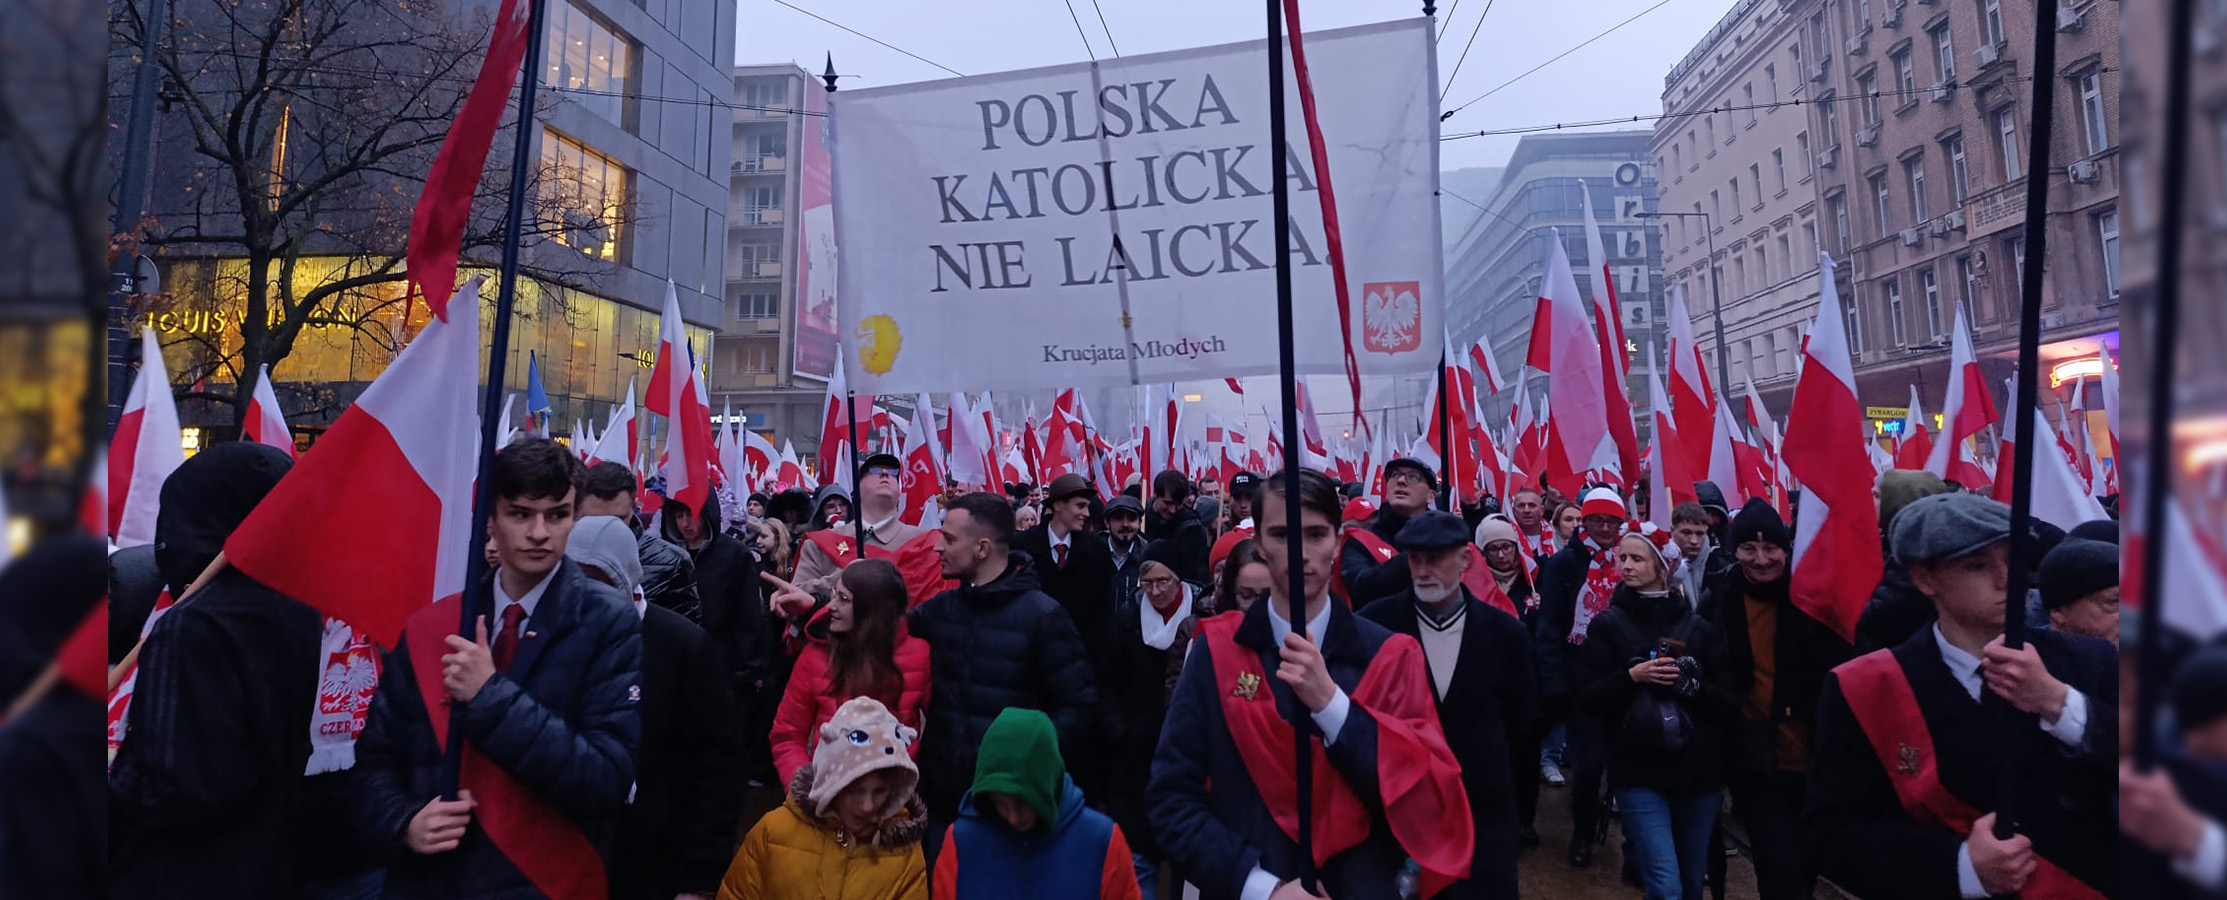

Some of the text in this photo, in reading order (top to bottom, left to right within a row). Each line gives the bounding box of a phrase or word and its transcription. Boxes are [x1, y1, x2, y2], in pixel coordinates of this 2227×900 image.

[975, 73, 1240, 150] POLSKA
[930, 140, 1318, 223] KATOLICKA
[928, 240, 1032, 292] NIE
[1614, 162, 1644, 325] Orbis
[1042, 335, 1226, 365] Krucjata Młodych
